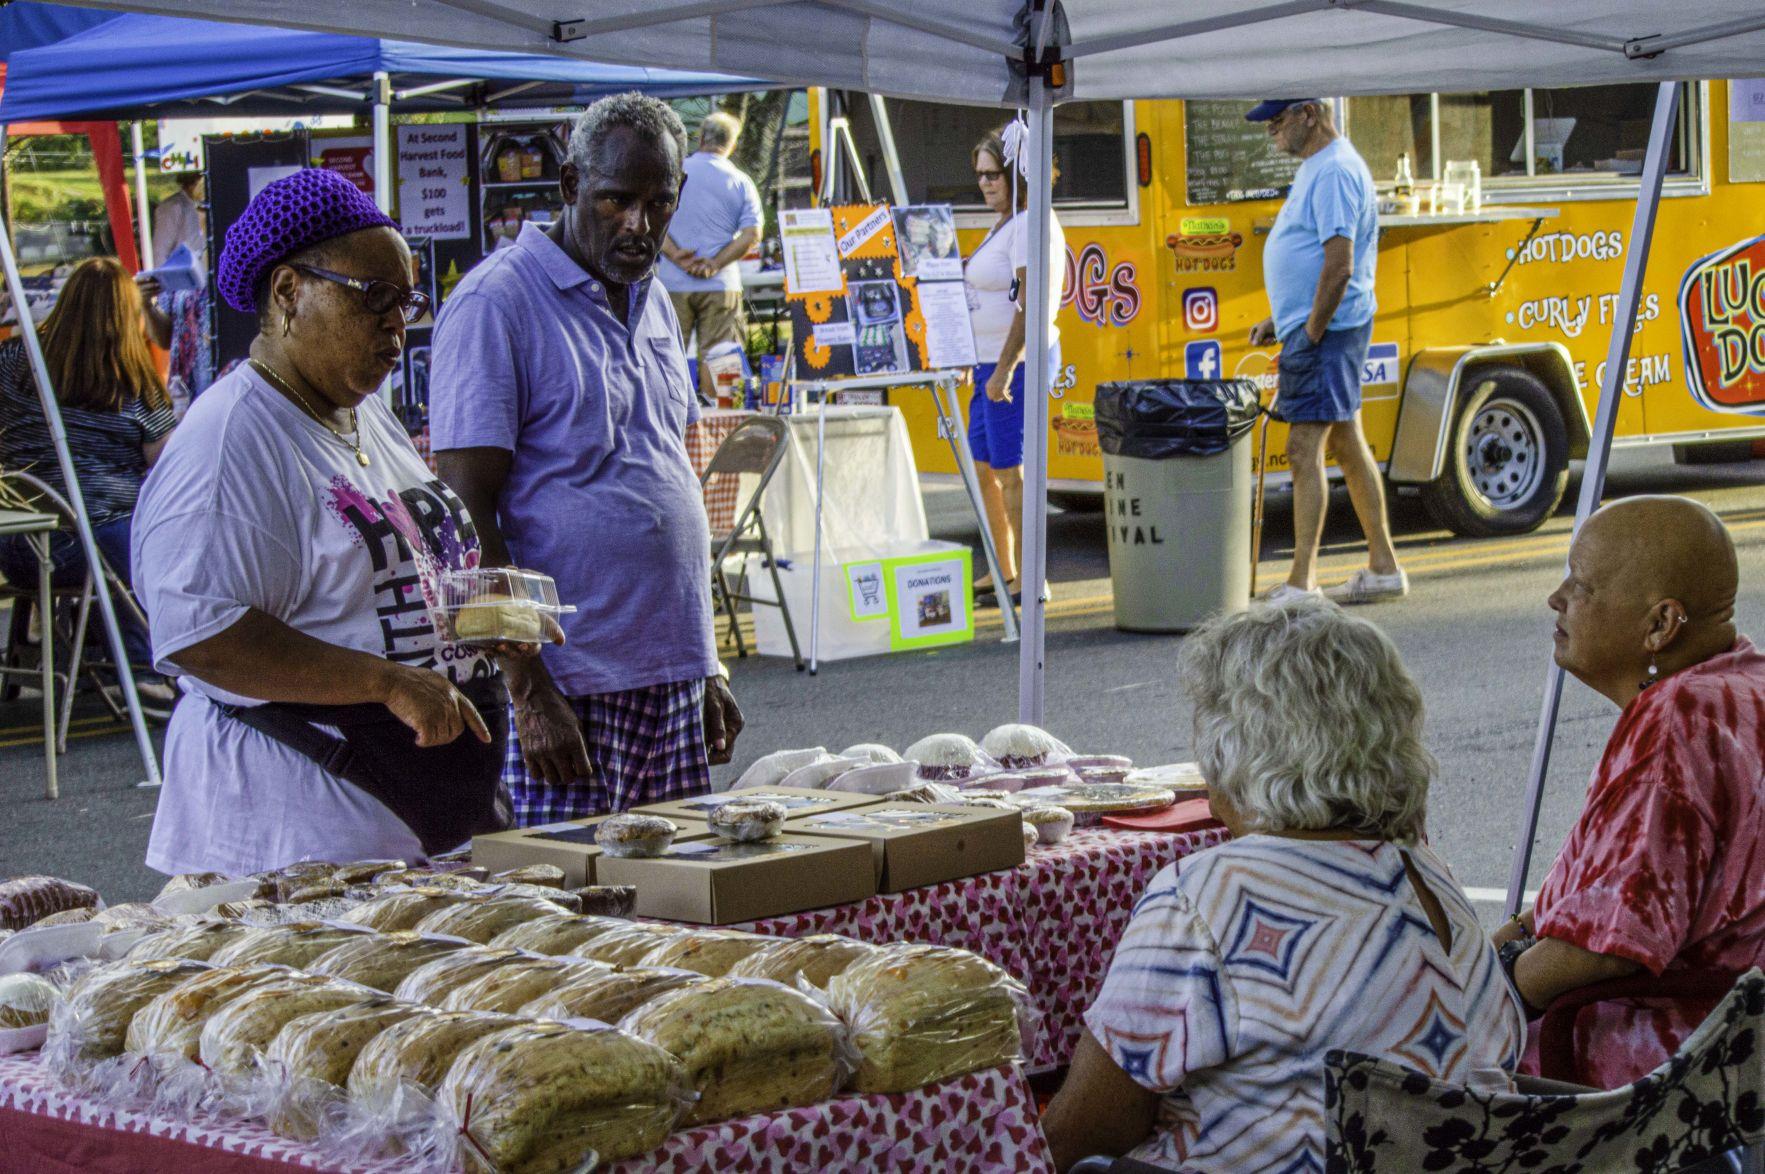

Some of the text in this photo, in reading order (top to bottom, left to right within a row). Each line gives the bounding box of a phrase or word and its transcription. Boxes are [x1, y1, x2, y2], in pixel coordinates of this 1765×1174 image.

[407, 131, 457, 144] At Second
[400, 148, 465, 161] Harvest Food
[418, 166, 447, 178] Bank,
[421, 188, 447, 201] $100
[424, 208, 445, 219] gets
[414, 221, 465, 234] truckload!
[840, 234, 857, 251] Our
[856, 211, 889, 240] Partners
[1518, 230, 1623, 263] HOTDOGS
[1063, 242, 1141, 328] GS
[1518, 294, 1592, 338] CURLY
[1361, 362, 1387, 383] SA
[1107, 471, 1124, 490] EN
[1110, 498, 1141, 516] INE
[1112, 525, 1165, 544] IVAL
[907, 574, 952, 589] DONATIONS
